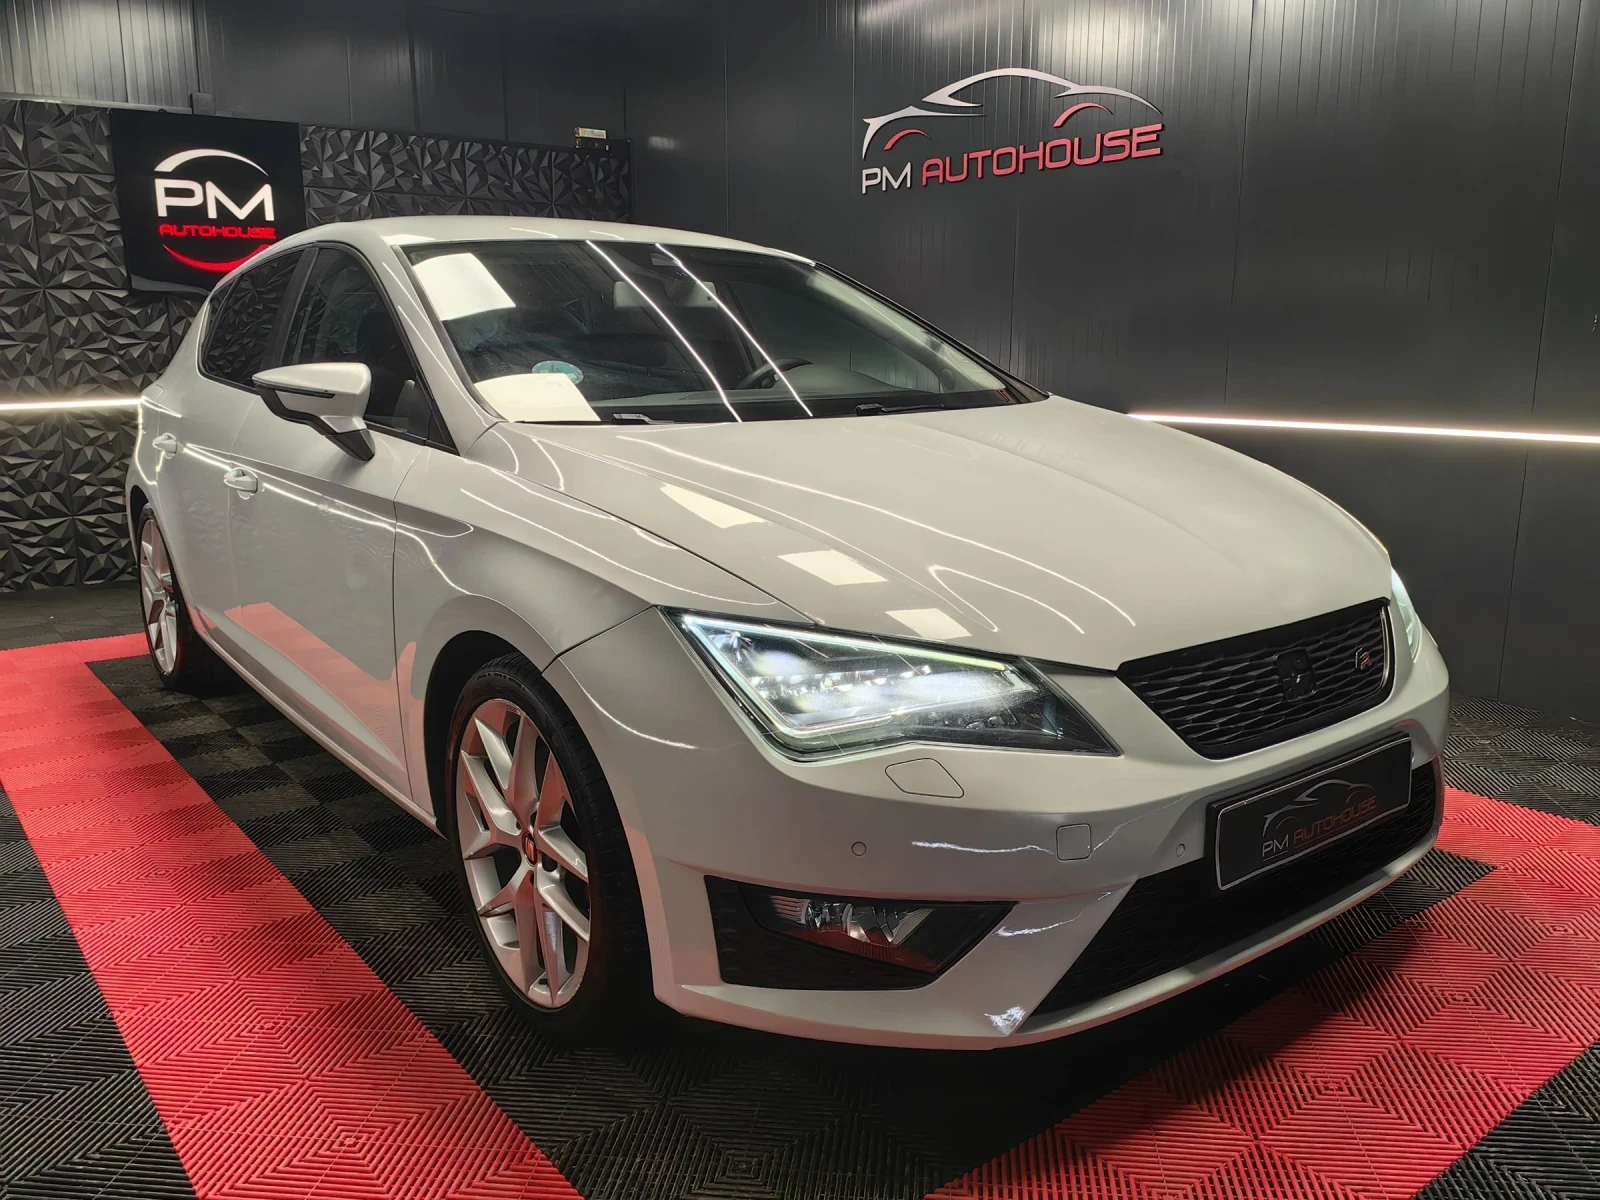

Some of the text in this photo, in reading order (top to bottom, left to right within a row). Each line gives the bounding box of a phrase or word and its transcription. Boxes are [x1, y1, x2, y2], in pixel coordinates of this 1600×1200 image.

[862, 123, 1162, 194] PM AUTOHOUSE
[154, 178, 275, 221] PM
[158, 223, 277, 239] AUTOHOUSE
[1262, 795, 1377, 857] PM AUTOHOUSE
